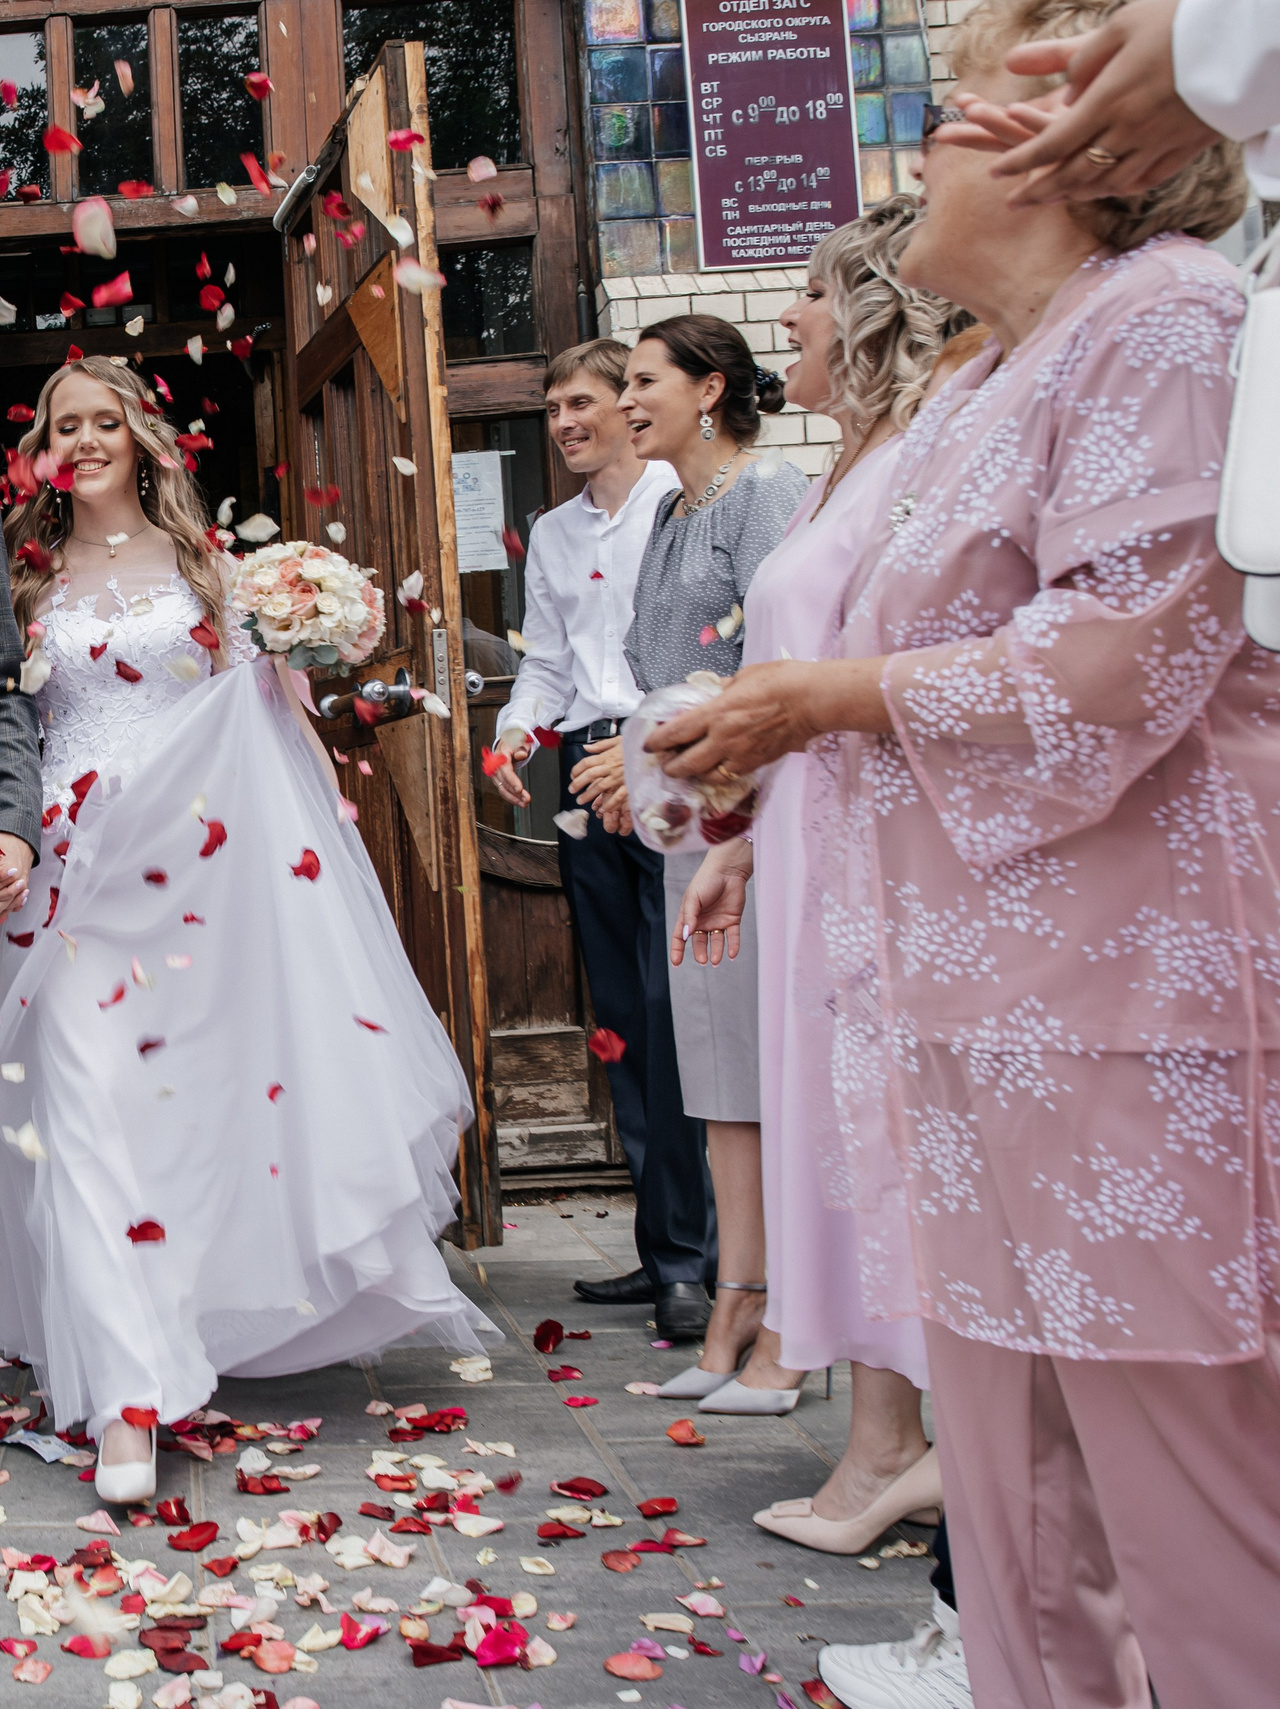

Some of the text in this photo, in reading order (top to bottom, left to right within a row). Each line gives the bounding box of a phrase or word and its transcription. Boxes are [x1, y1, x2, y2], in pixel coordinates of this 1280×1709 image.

[718, 0, 770, 14] ОТДЕЛ
[702, 16, 831, 32] ГОРОДСКОГО ОКРУГА
[738, 32, 798, 43] СЫЗРАНЬ
[708, 47, 830, 64] РЕЖИМ РАБОТЫ
[700, 82, 720, 94] ВТ
[702, 98, 722, 110] СР
[702, 113, 723, 124] ЧТ
[776, 106, 800, 125] до
[704, 129, 724, 142] ПТ
[705, 145, 727, 158] СБ
[745, 154, 803, 166] ПЕРЕРЫВ
[777, 178, 796, 193] до
[722, 198, 738, 208] ВС
[748, 201, 831, 213] ВЫХОДНЫЕ ДНИ
[722, 210, 740, 220] ПН
[727, 221, 836, 235] САНИТАРНЫЙ ДЕНЬ
[722, 234, 790, 247] ПОСЛЕДНИЙ
[732, 247, 785, 258] КАЖДОГО
